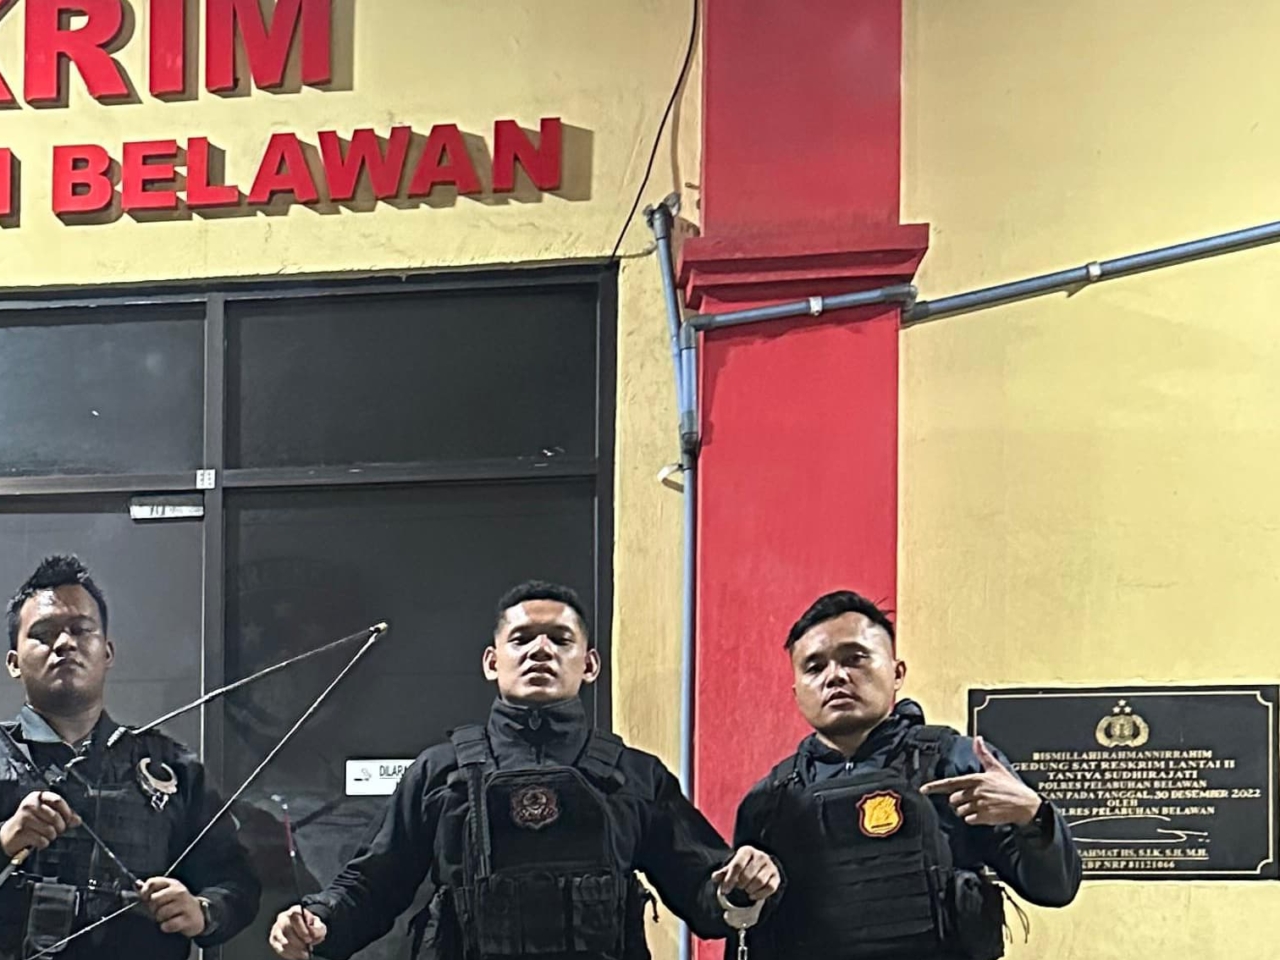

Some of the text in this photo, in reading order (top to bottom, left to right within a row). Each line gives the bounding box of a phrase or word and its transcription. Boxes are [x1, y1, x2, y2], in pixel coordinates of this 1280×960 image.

[52, 117, 562, 219] BELAWAN
[1012, 761, 1069, 771] GEDUNG
[1071, 761, 1098, 770] SAT
[1100, 760, 1165, 770] RESKRIM
[1168, 760, 1221, 769] LANTAI
[1038, 780, 1208, 790] POLRES PELABUHAN BELAWAN
[1066, 791, 1094, 800] PADA
[1171, 789, 1229, 799] DESEMBER
[1231, 788, 1262, 798] 2022
[1106, 799, 1138, 807] OLEH
[1092, 806, 1159, 816] PELABUHAN
[1161, 806, 1215, 815] BELAWAN
